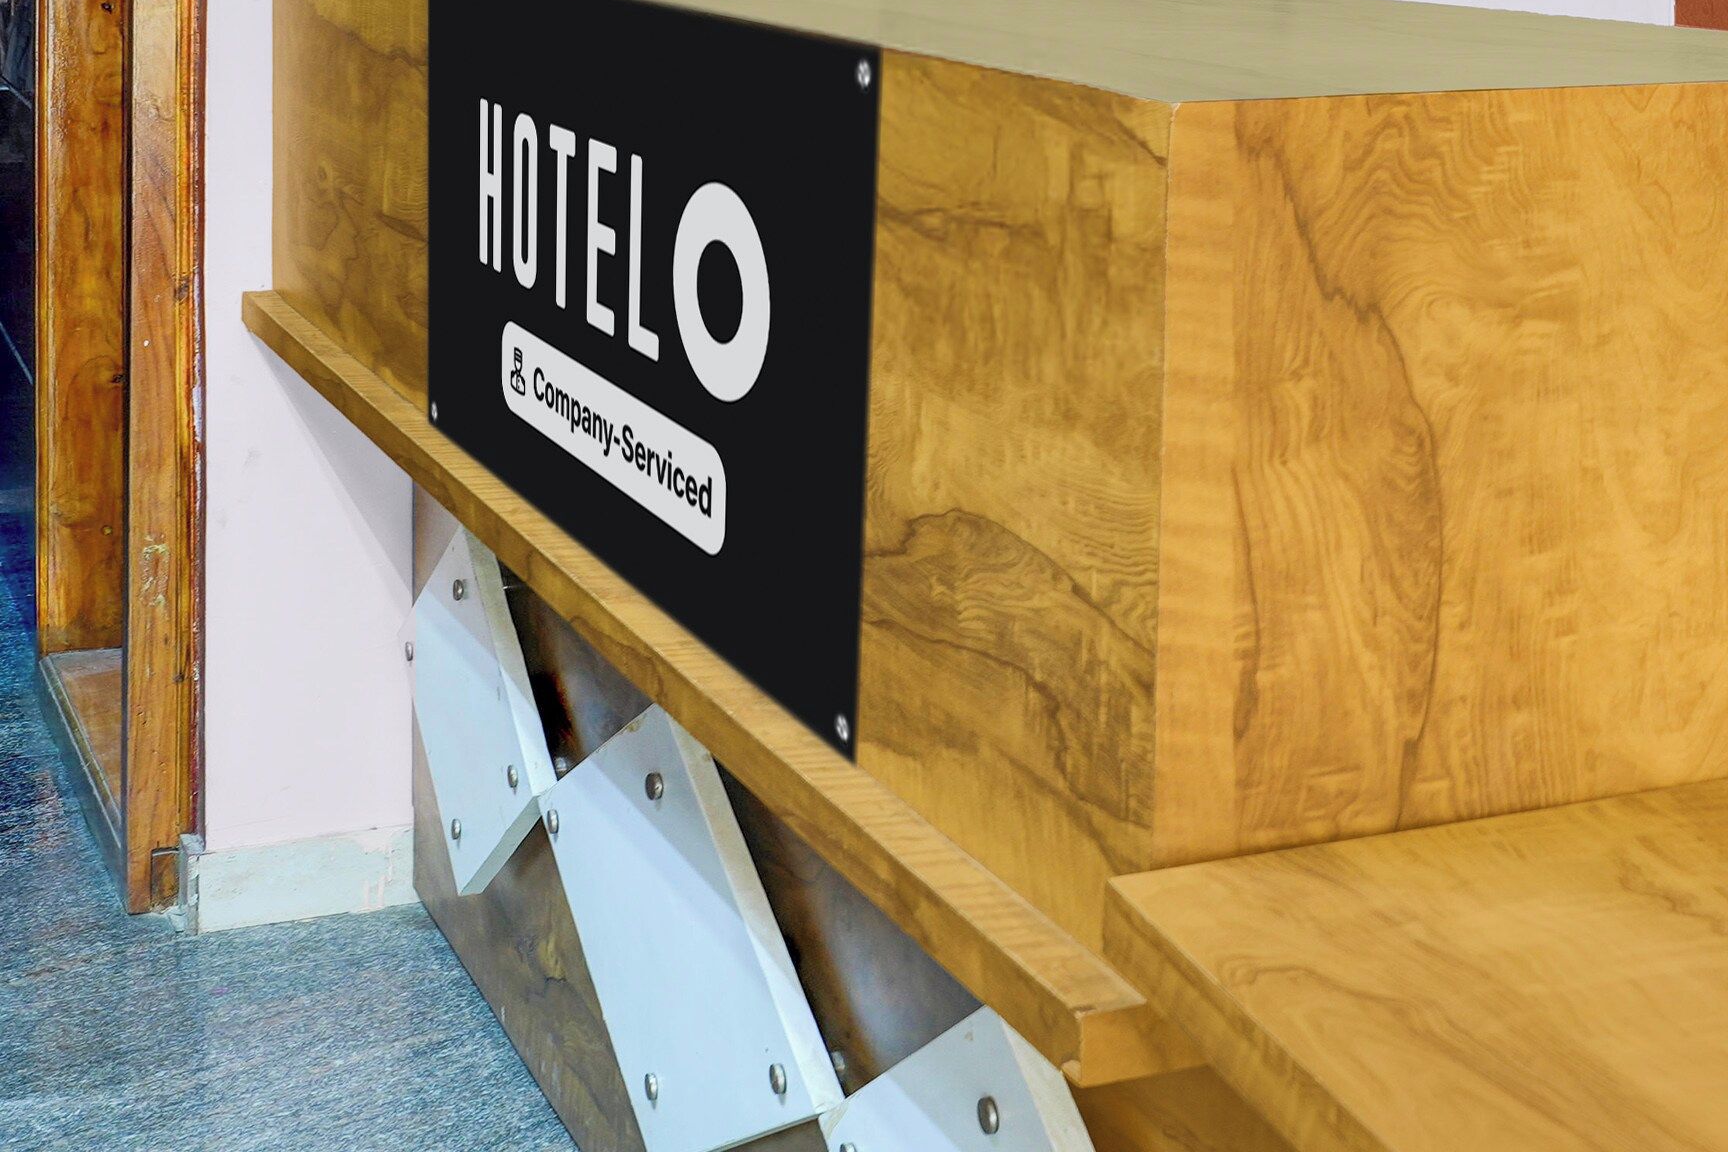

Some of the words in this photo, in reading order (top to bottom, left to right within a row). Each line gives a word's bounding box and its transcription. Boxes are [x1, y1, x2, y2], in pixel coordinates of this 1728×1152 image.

[479, 98, 660, 362] HOTEL
[672, 182, 771, 402] O
[533, 366, 713, 519] Company-Serviced
